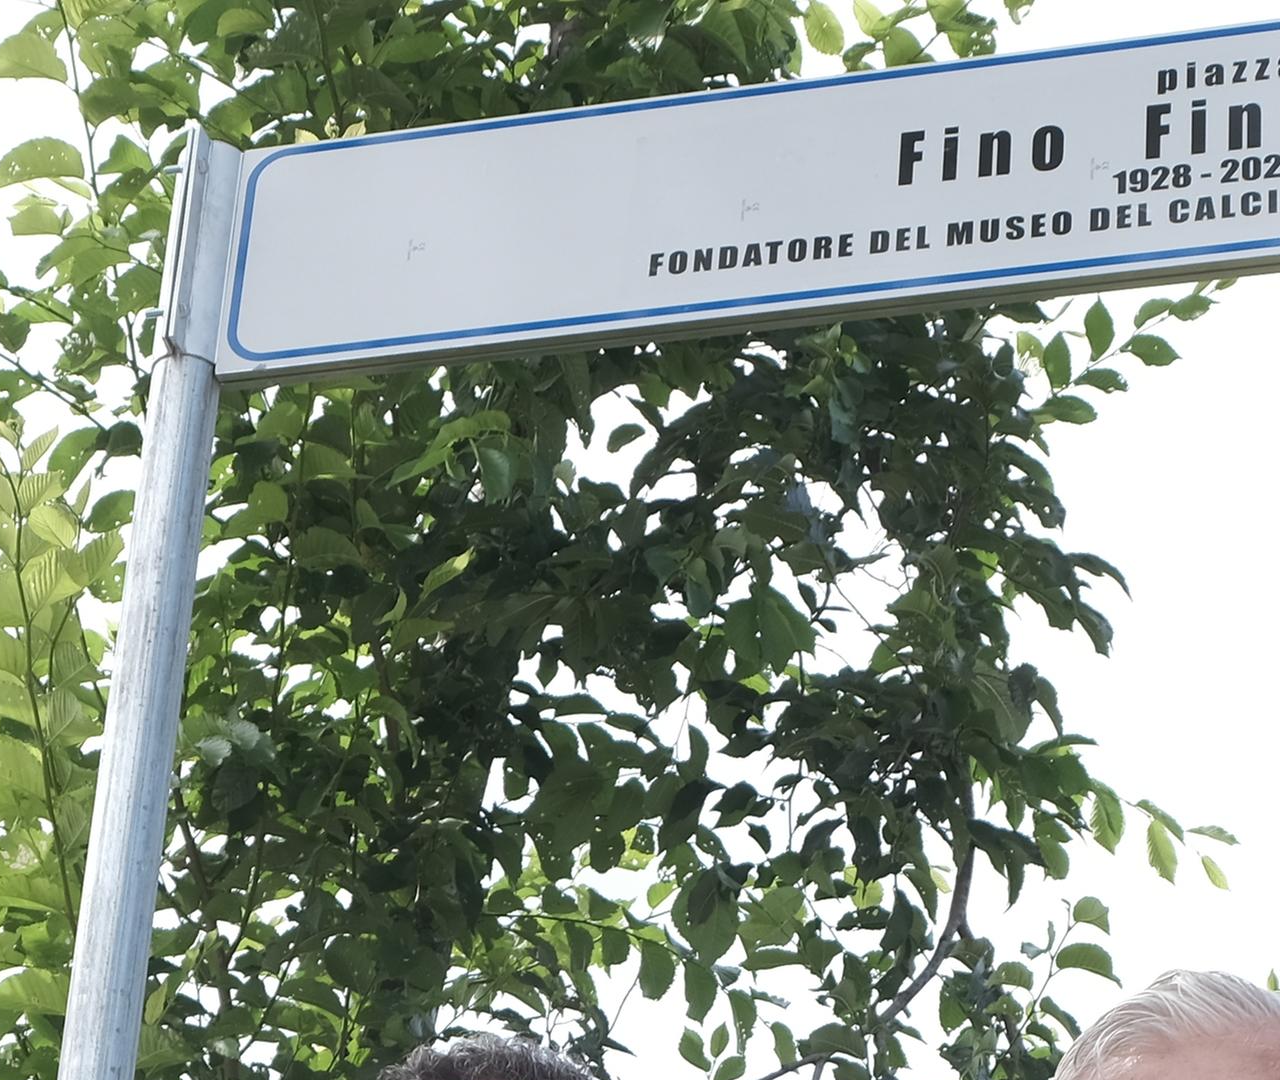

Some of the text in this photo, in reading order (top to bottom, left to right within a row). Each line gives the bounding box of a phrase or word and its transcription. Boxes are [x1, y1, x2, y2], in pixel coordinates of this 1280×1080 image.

[897, 124, 1065, 187] Fino
[648, 233, 854, 277] FONDATORE
[869, 225, 930, 255] DEL
[946, 210, 1073, 247] MUSEO
[1089, 202, 1152, 232] DEL
